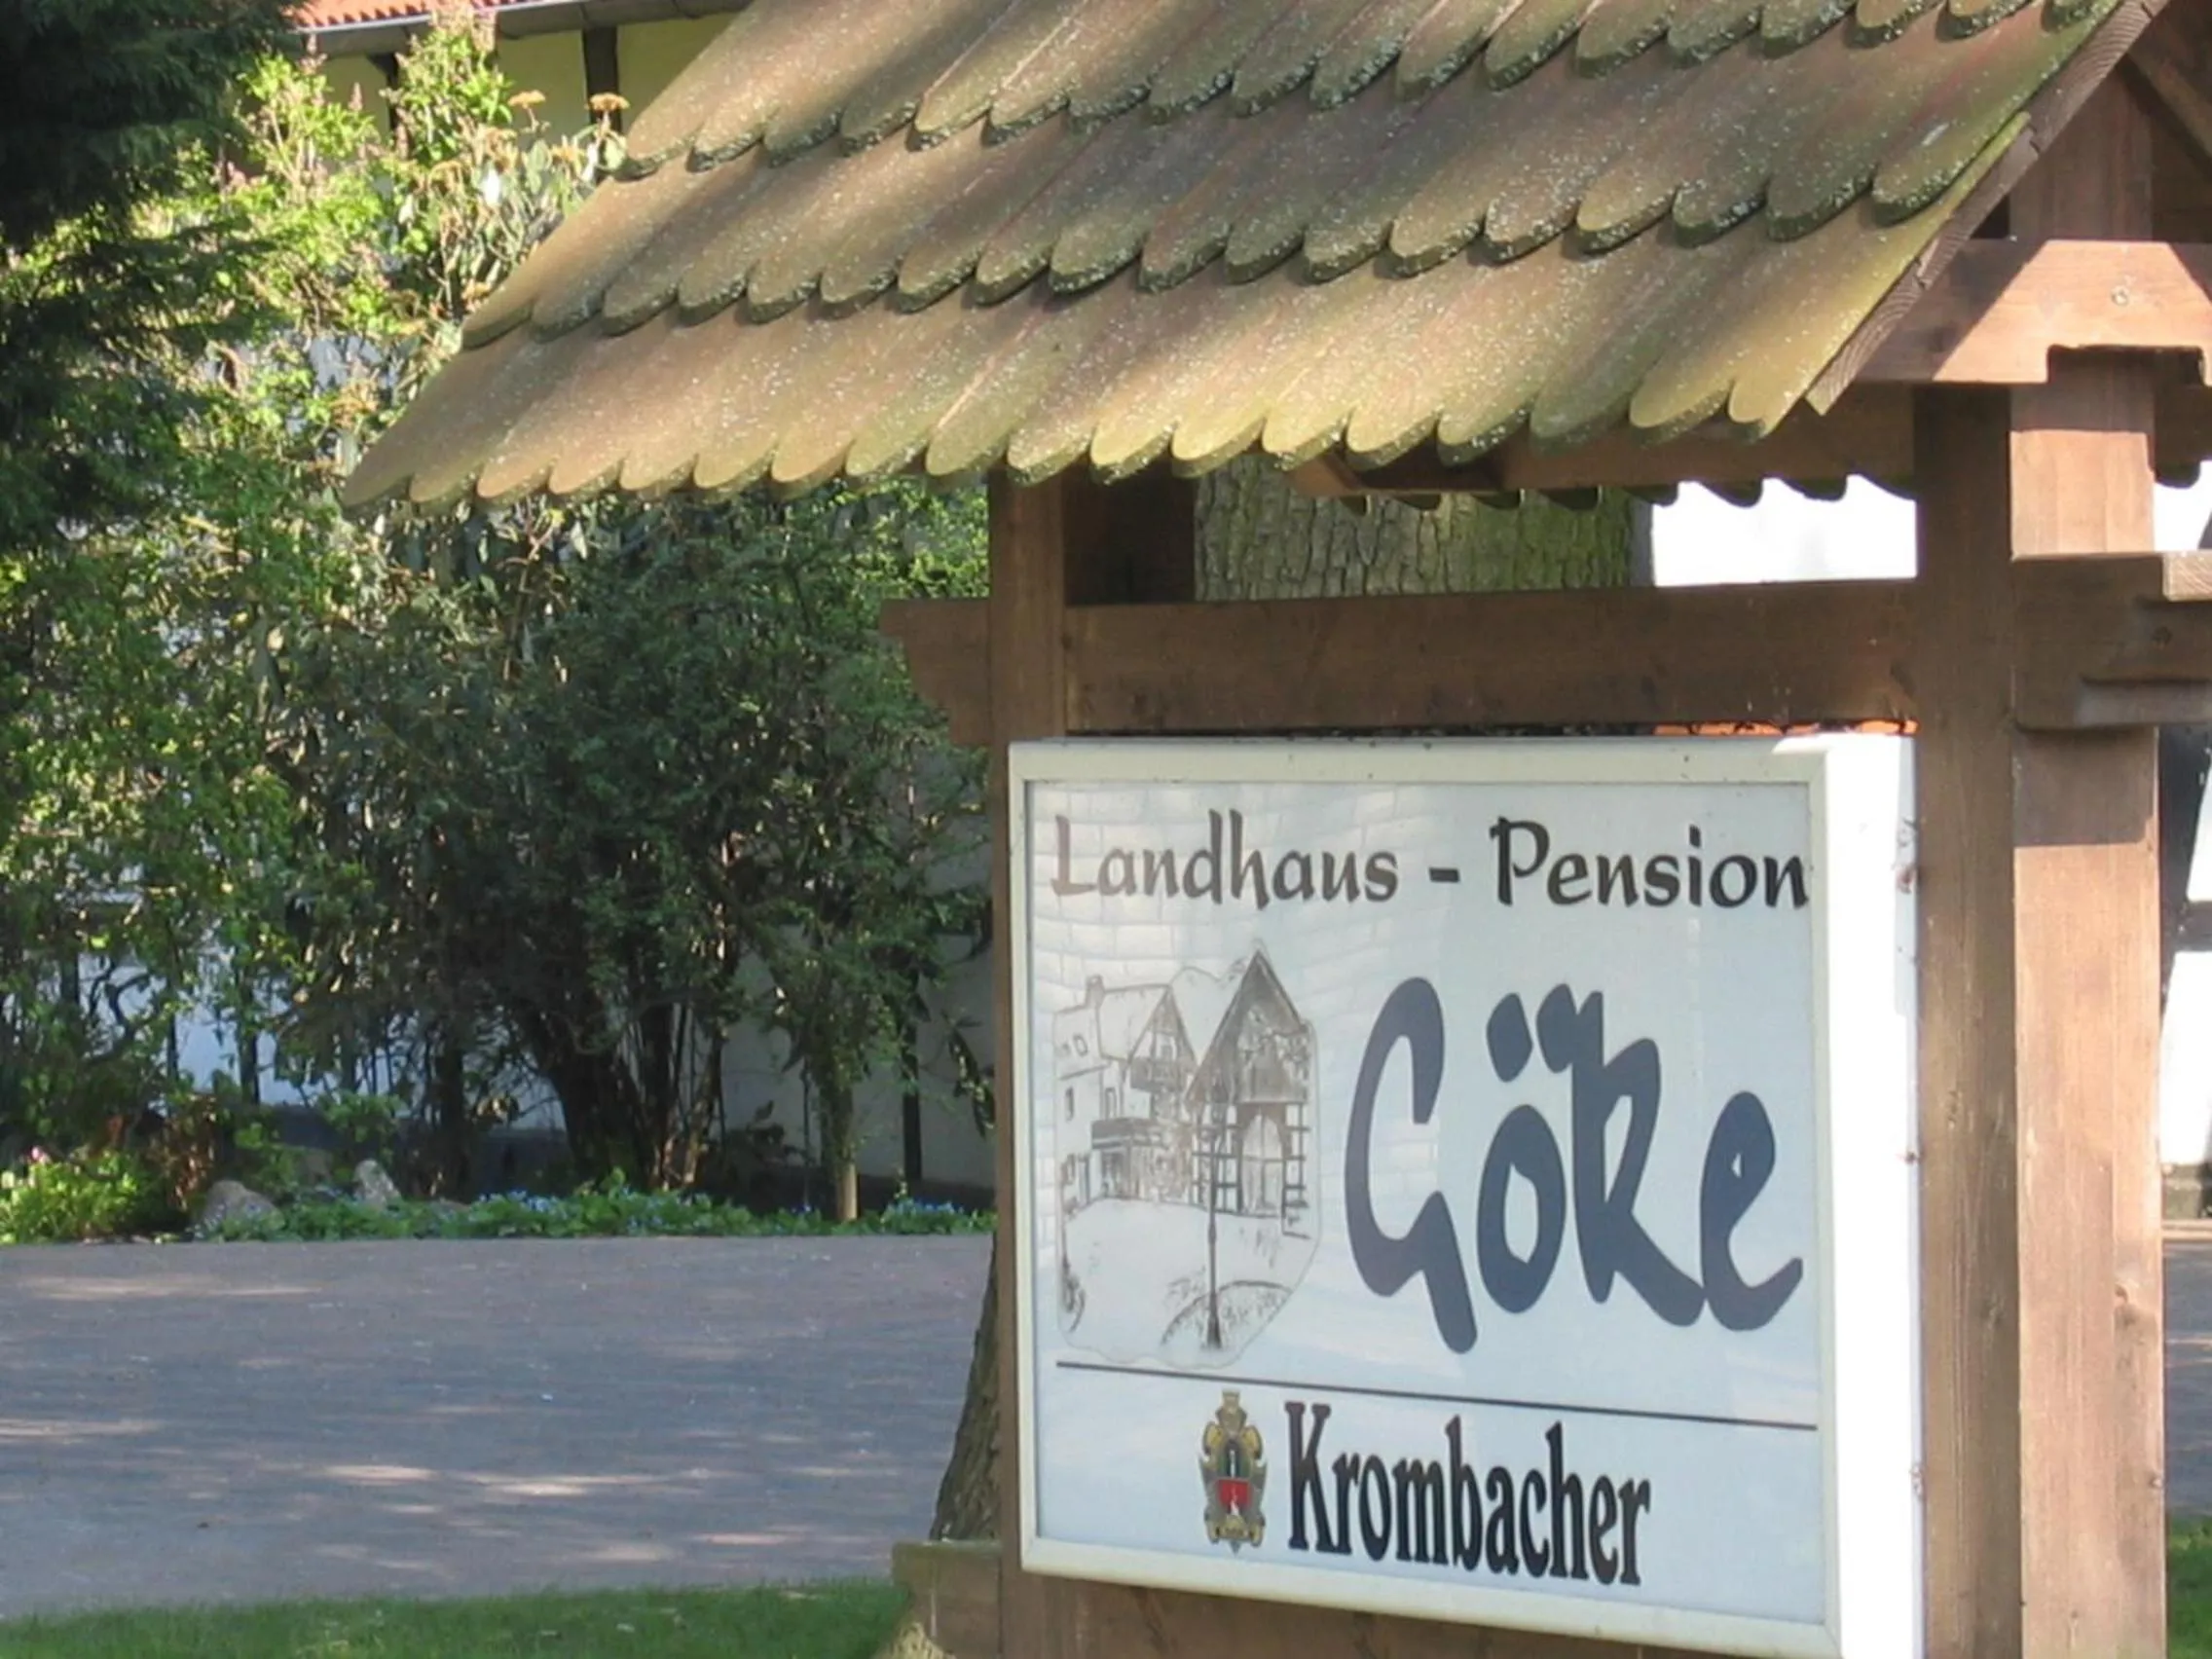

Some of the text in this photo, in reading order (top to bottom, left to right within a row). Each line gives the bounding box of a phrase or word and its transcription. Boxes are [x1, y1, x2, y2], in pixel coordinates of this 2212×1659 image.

[1051, 810, 1398, 910] Landhaus
[1490, 816, 1809, 908] Pension
[1283, 1402, 1650, 1586] Krombacher
